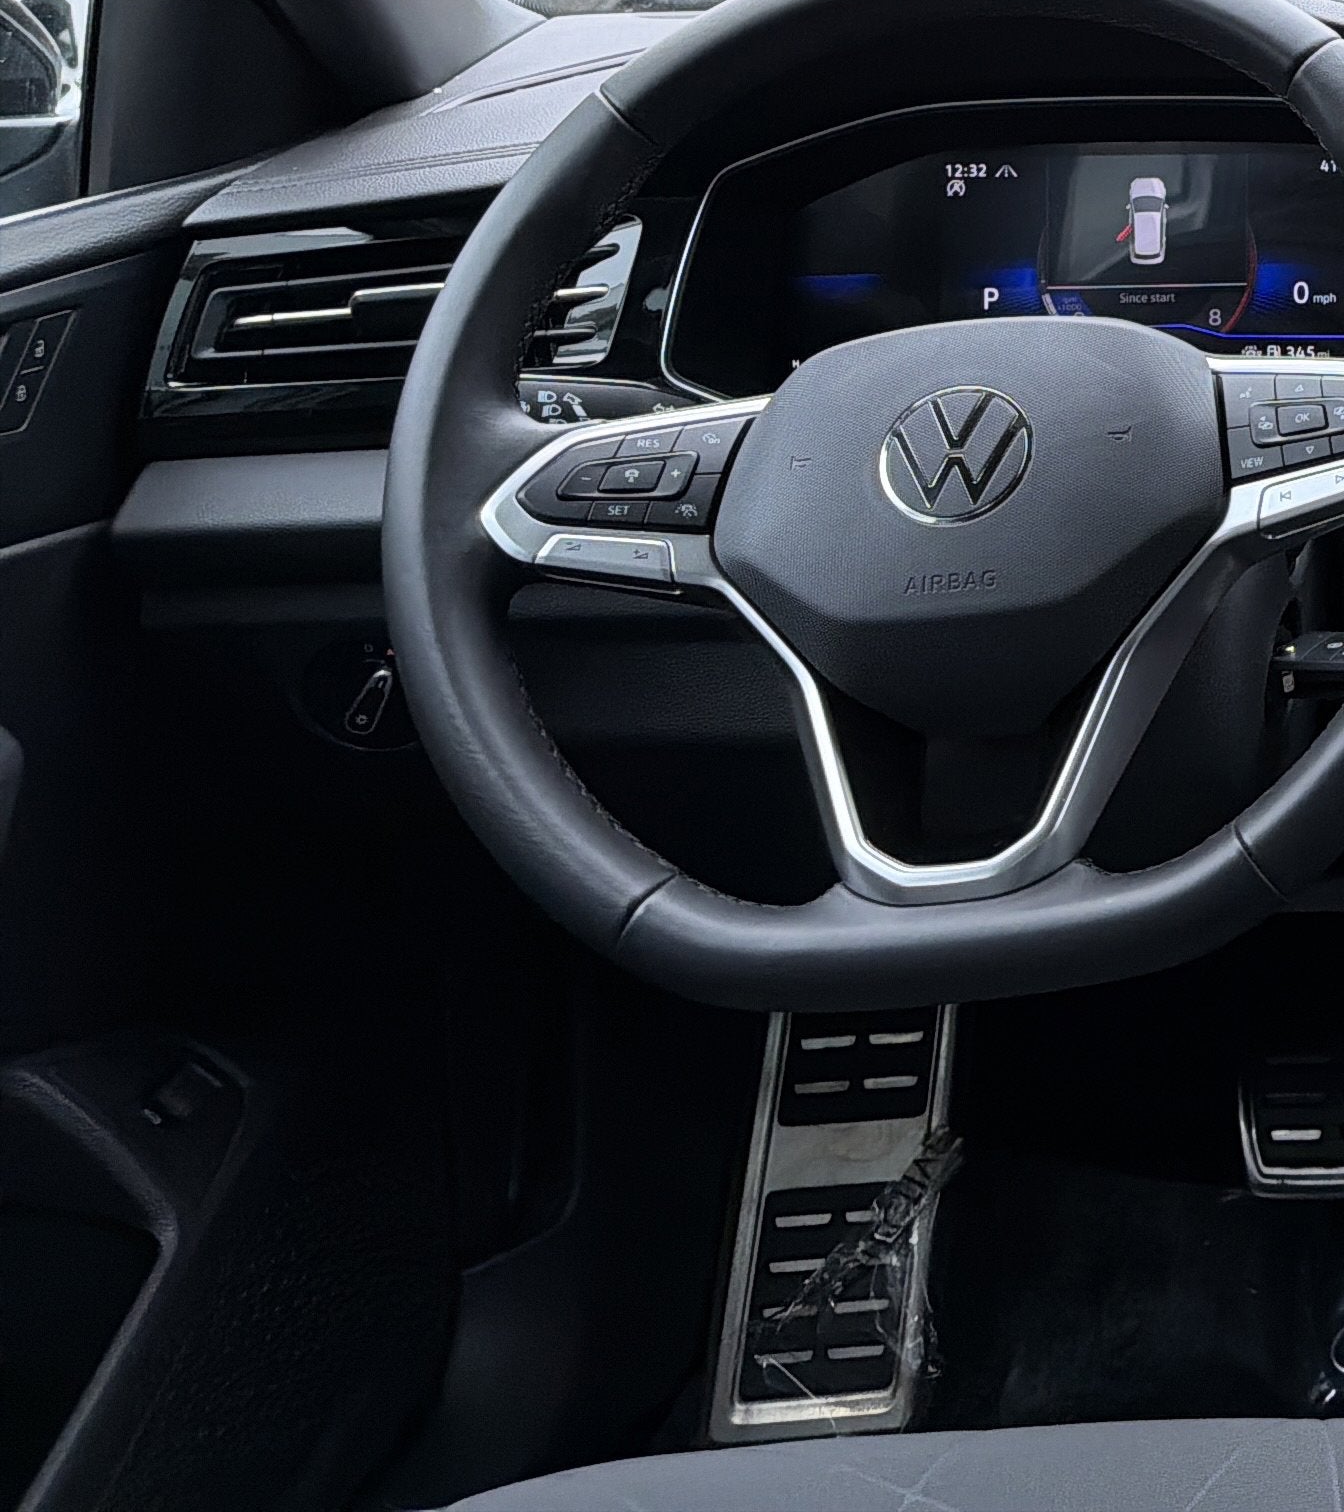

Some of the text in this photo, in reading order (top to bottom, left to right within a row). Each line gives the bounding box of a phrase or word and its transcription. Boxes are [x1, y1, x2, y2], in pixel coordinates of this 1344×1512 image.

[945, 163, 988, 178] 12:32
[983, 286, 999, 311] P
[1119, 291, 1176, 304] Since start
[1292, 280, 1337, 305] 0 mph
[1208, 308, 1222, 326] 8
[1285, 346, 1316, 358] 345
[1295, 412, 1311, 423] OK
[636, 437, 661, 449] RES
[1240, 455, 1264, 469] VIEW
[606, 504, 632, 517] SET
[901, 568, 998, 596] AIRBAG
